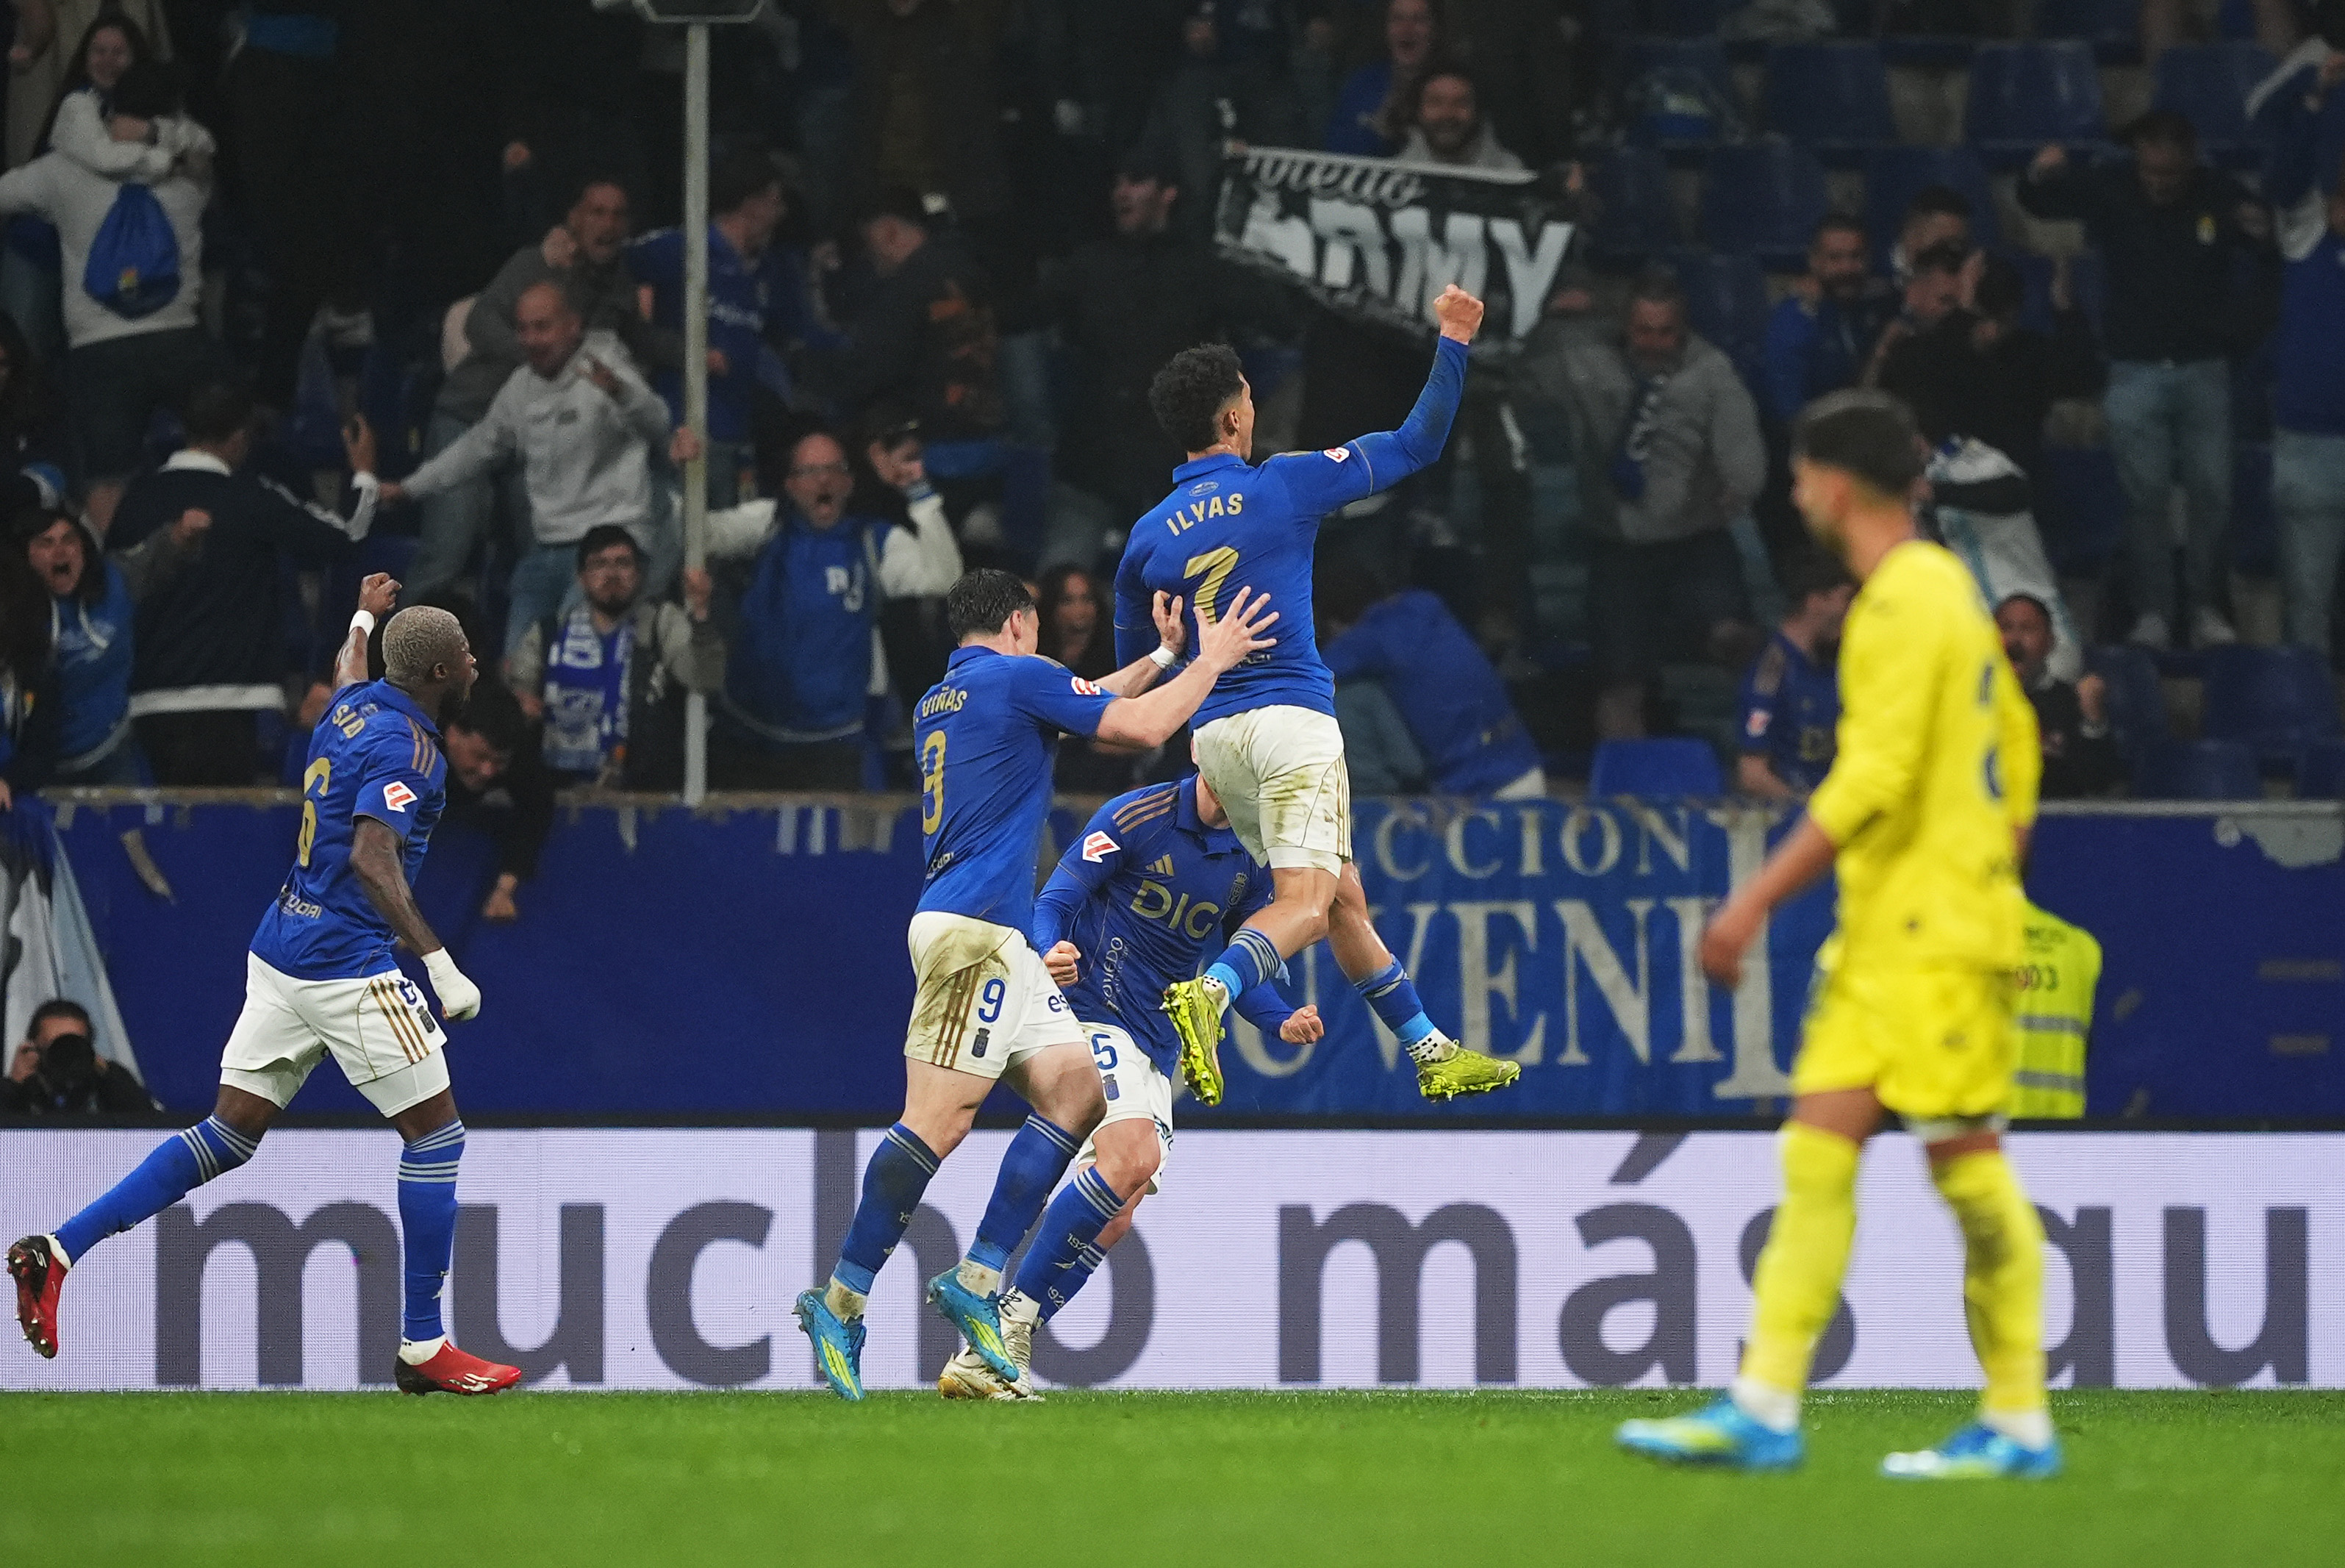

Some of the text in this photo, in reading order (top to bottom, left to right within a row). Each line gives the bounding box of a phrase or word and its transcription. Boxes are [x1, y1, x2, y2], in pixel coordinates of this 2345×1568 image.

[1166, 493, 1244, 537] ILYAS
[1184, 545, 1239, 626] 7
[922, 686, 968, 717] VIÑAS
[298, 757, 331, 867] 6
[922, 730, 947, 836] 9
[1373, 806, 1692, 881] CCION
[978, 978, 1006, 1023] 9
[1091, 1034, 1118, 1070] 5
[155, 1129, 1156, 1389] mucho
[1276, 1132, 1857, 1388] más
